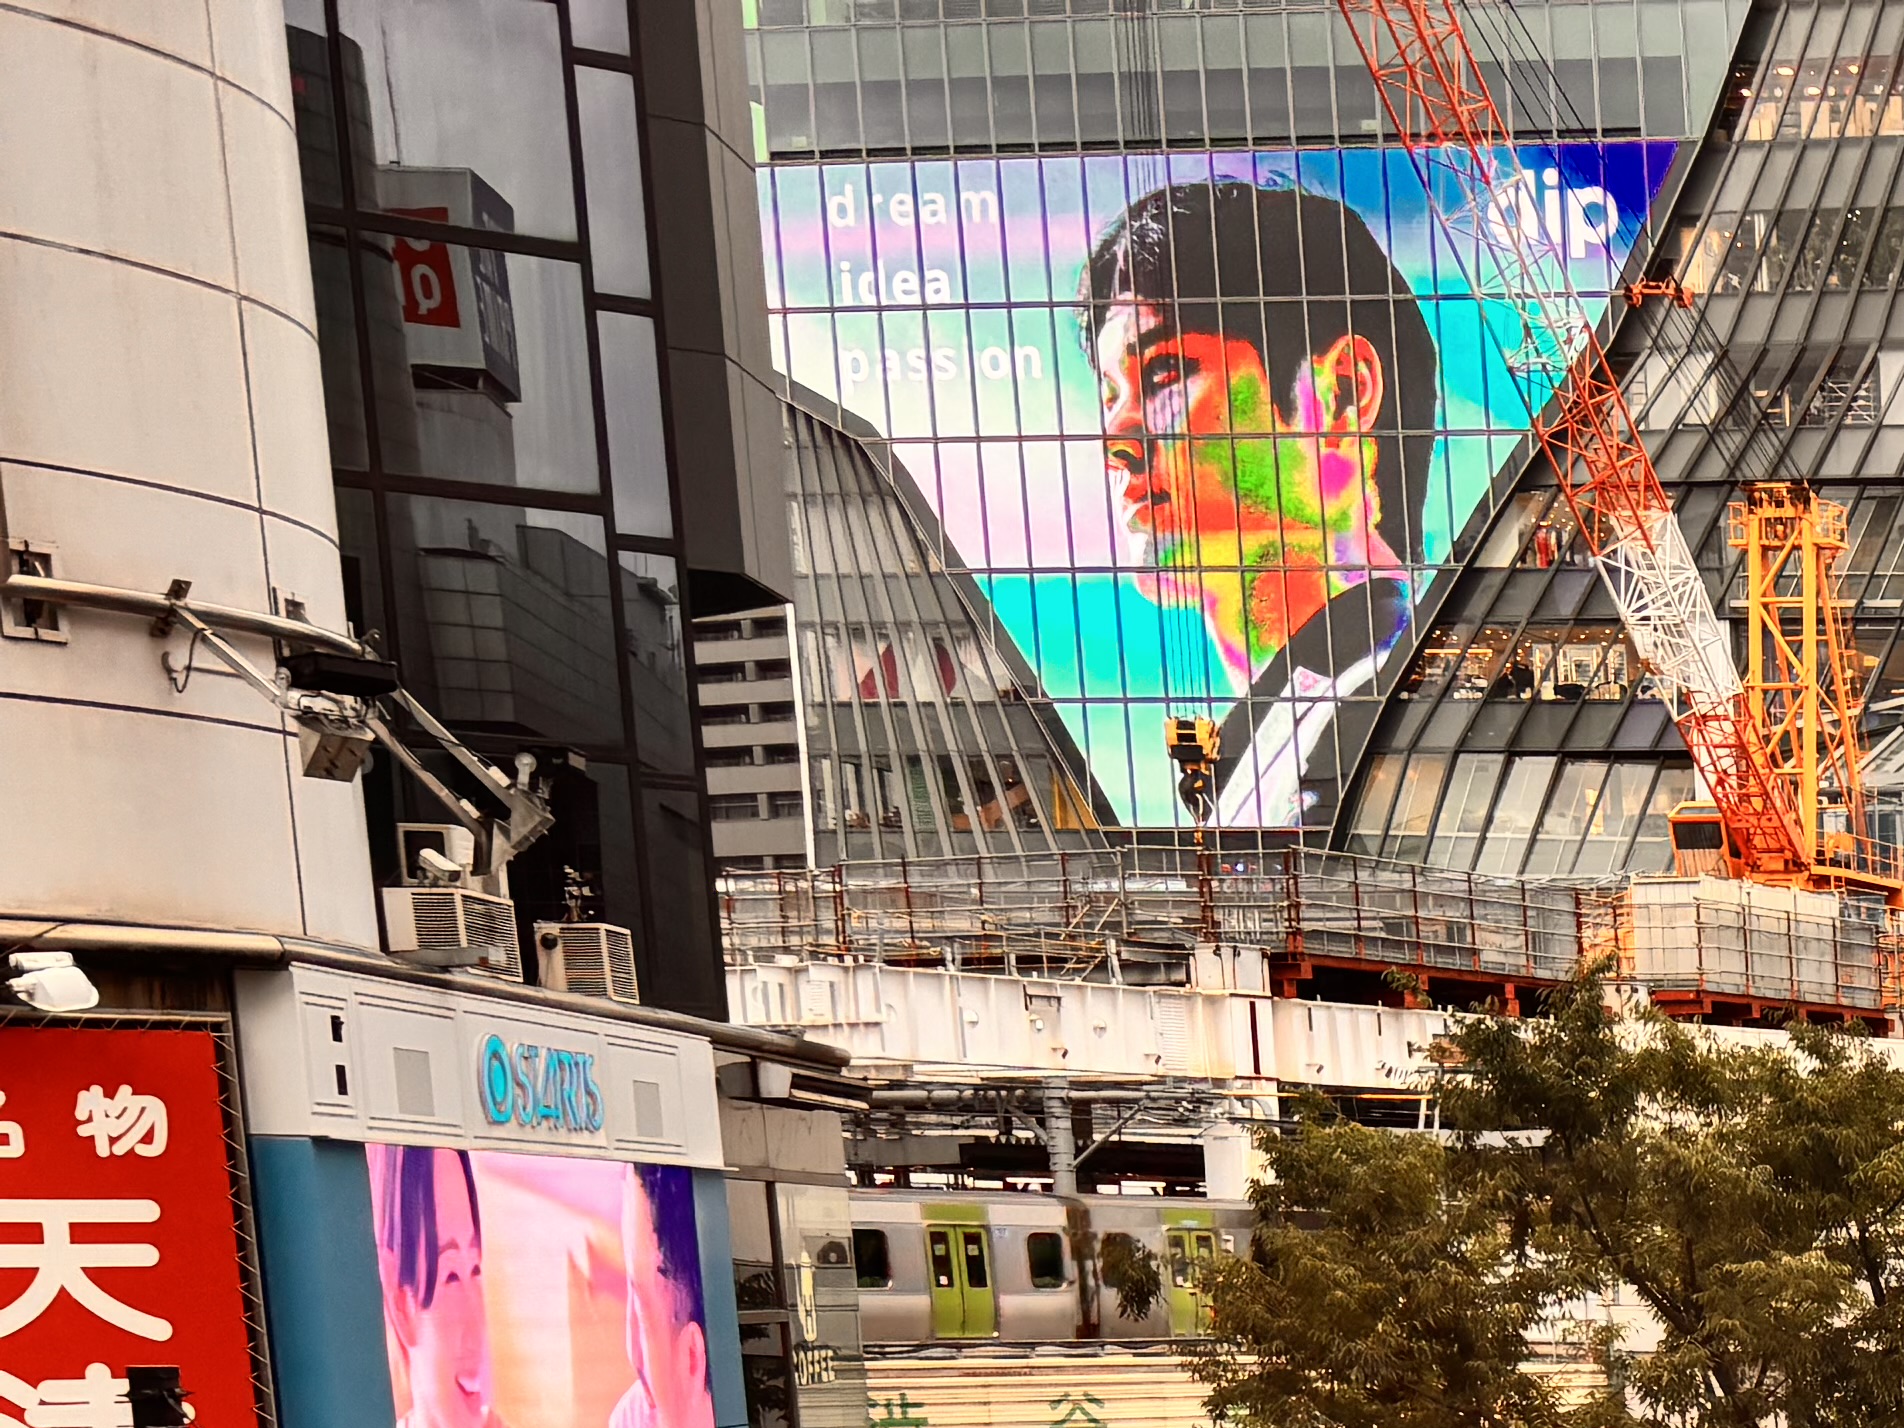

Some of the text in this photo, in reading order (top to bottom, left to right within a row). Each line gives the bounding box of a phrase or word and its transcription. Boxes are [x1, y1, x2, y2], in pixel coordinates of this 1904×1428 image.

[829, 180, 999, 229] dream
[1486, 169, 1619, 259] dip
[839, 262, 950, 305] idea
[840, 337, 1042, 386] passion
[512, 1047, 603, 1131] STARTS
